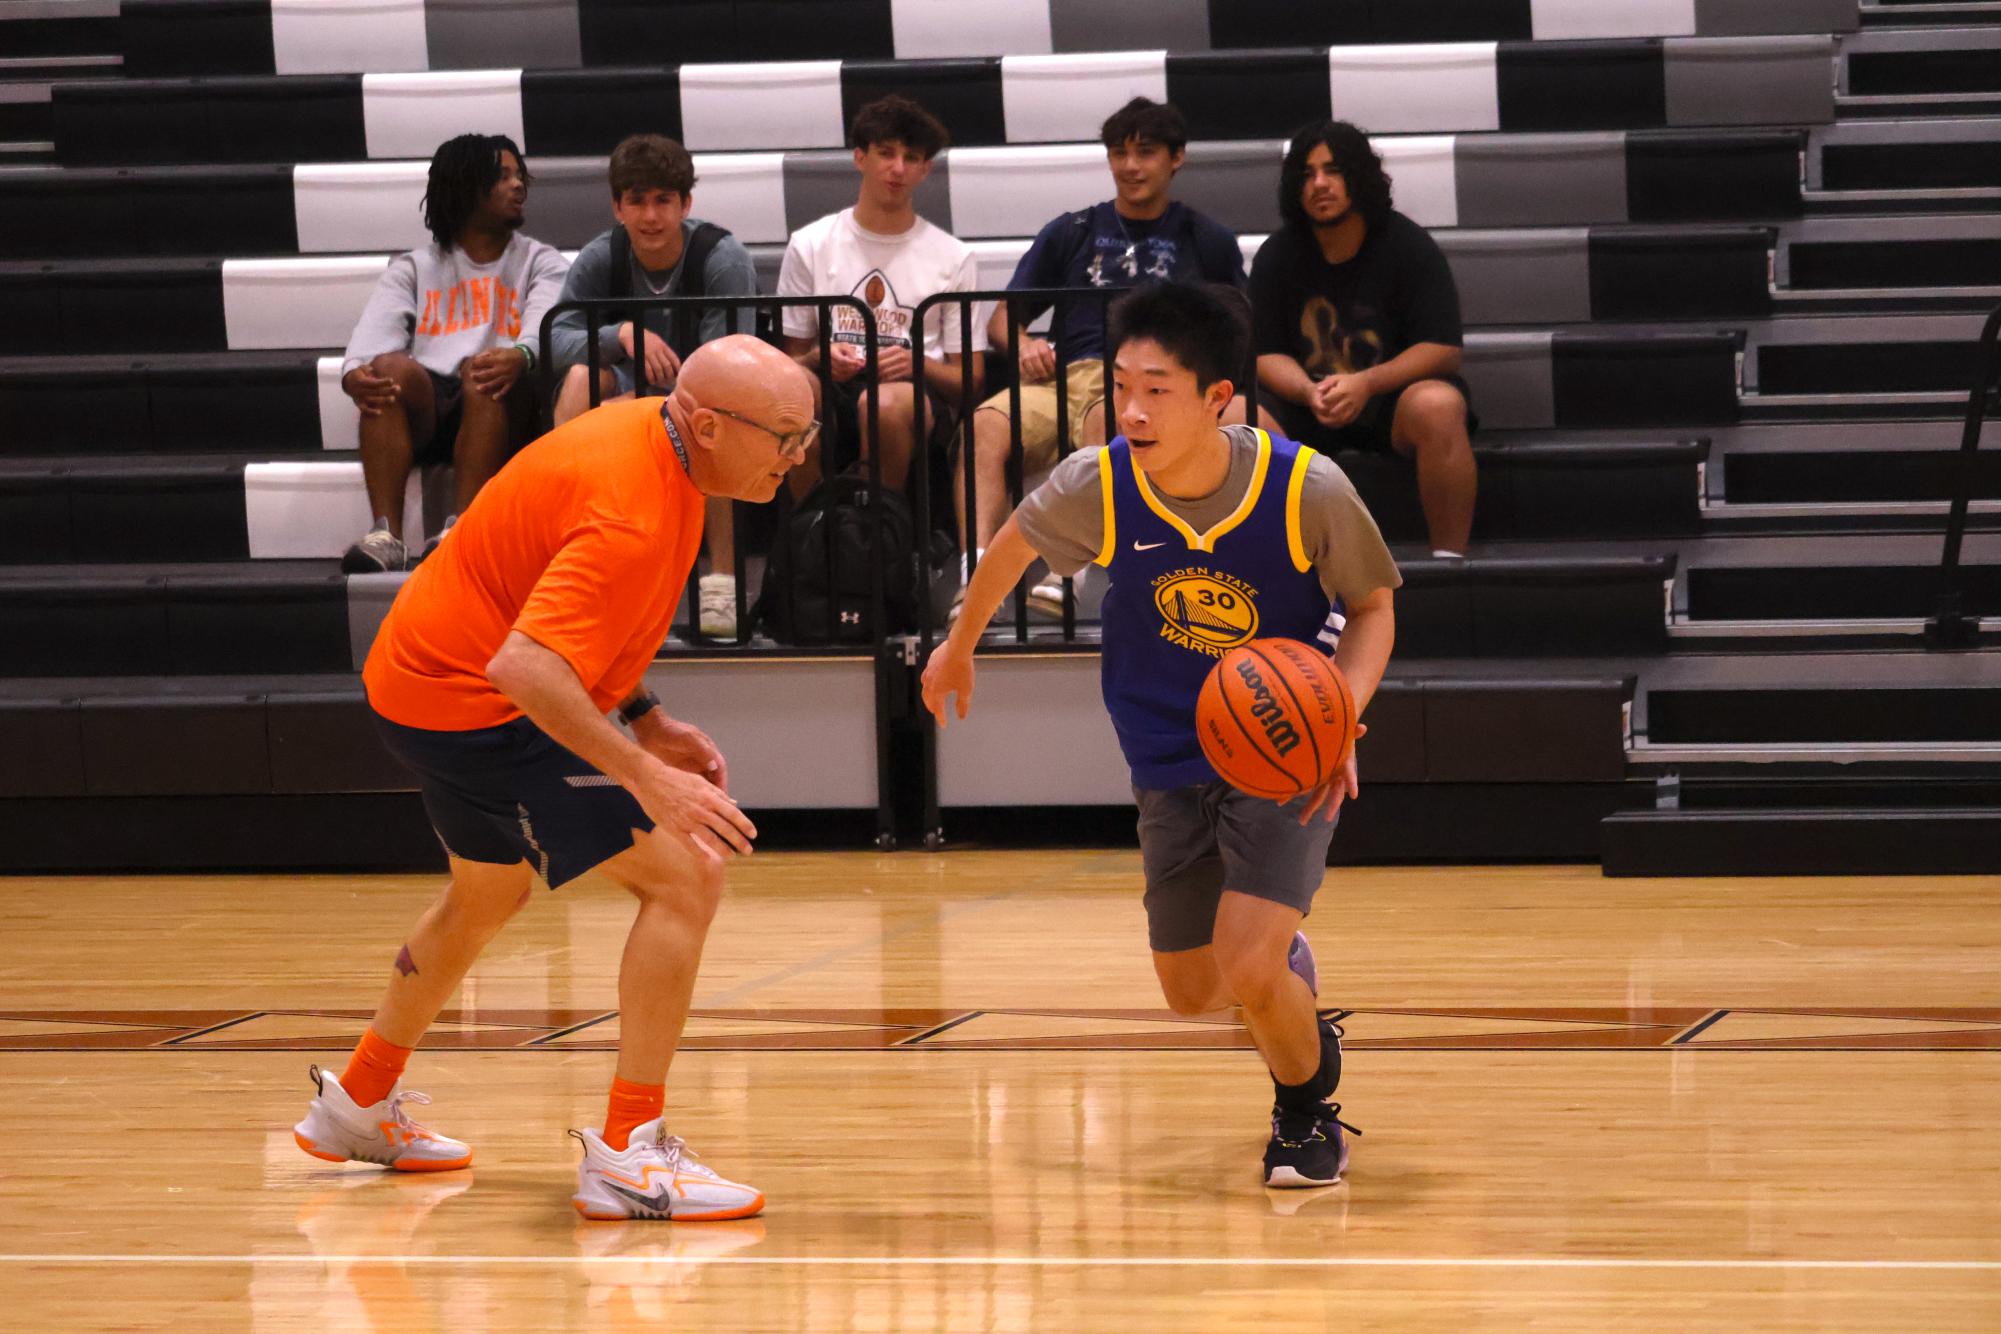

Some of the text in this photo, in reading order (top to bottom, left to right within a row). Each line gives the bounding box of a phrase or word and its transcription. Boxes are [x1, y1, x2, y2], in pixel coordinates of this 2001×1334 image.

[838, 307, 907, 325] WESWOOD
[1151, 567, 1259, 598] GOLDEN STATE
[1198, 589, 1236, 610] 30
[1237, 658, 1301, 759] Wilson
